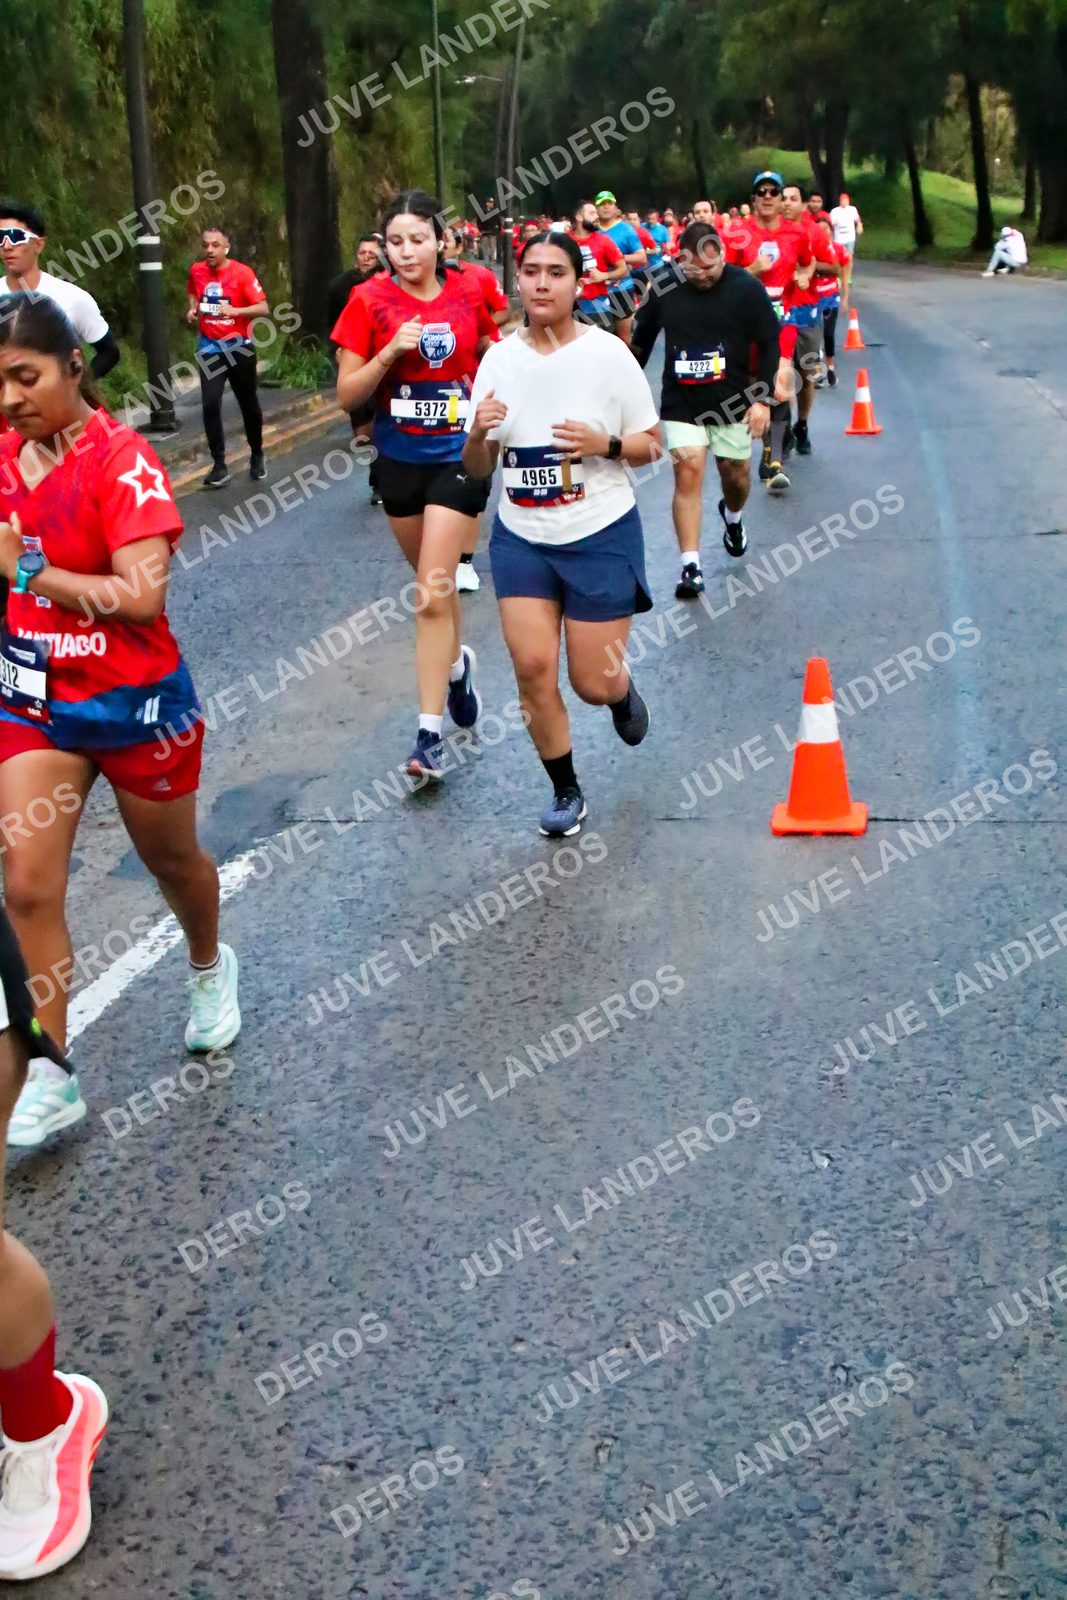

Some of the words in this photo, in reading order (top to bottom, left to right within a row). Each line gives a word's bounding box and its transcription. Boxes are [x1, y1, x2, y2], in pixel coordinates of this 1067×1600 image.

[689, 361, 710, 372] 4222
[415, 402, 447, 417] 5372
[522, 468, 557, 486] 4965
